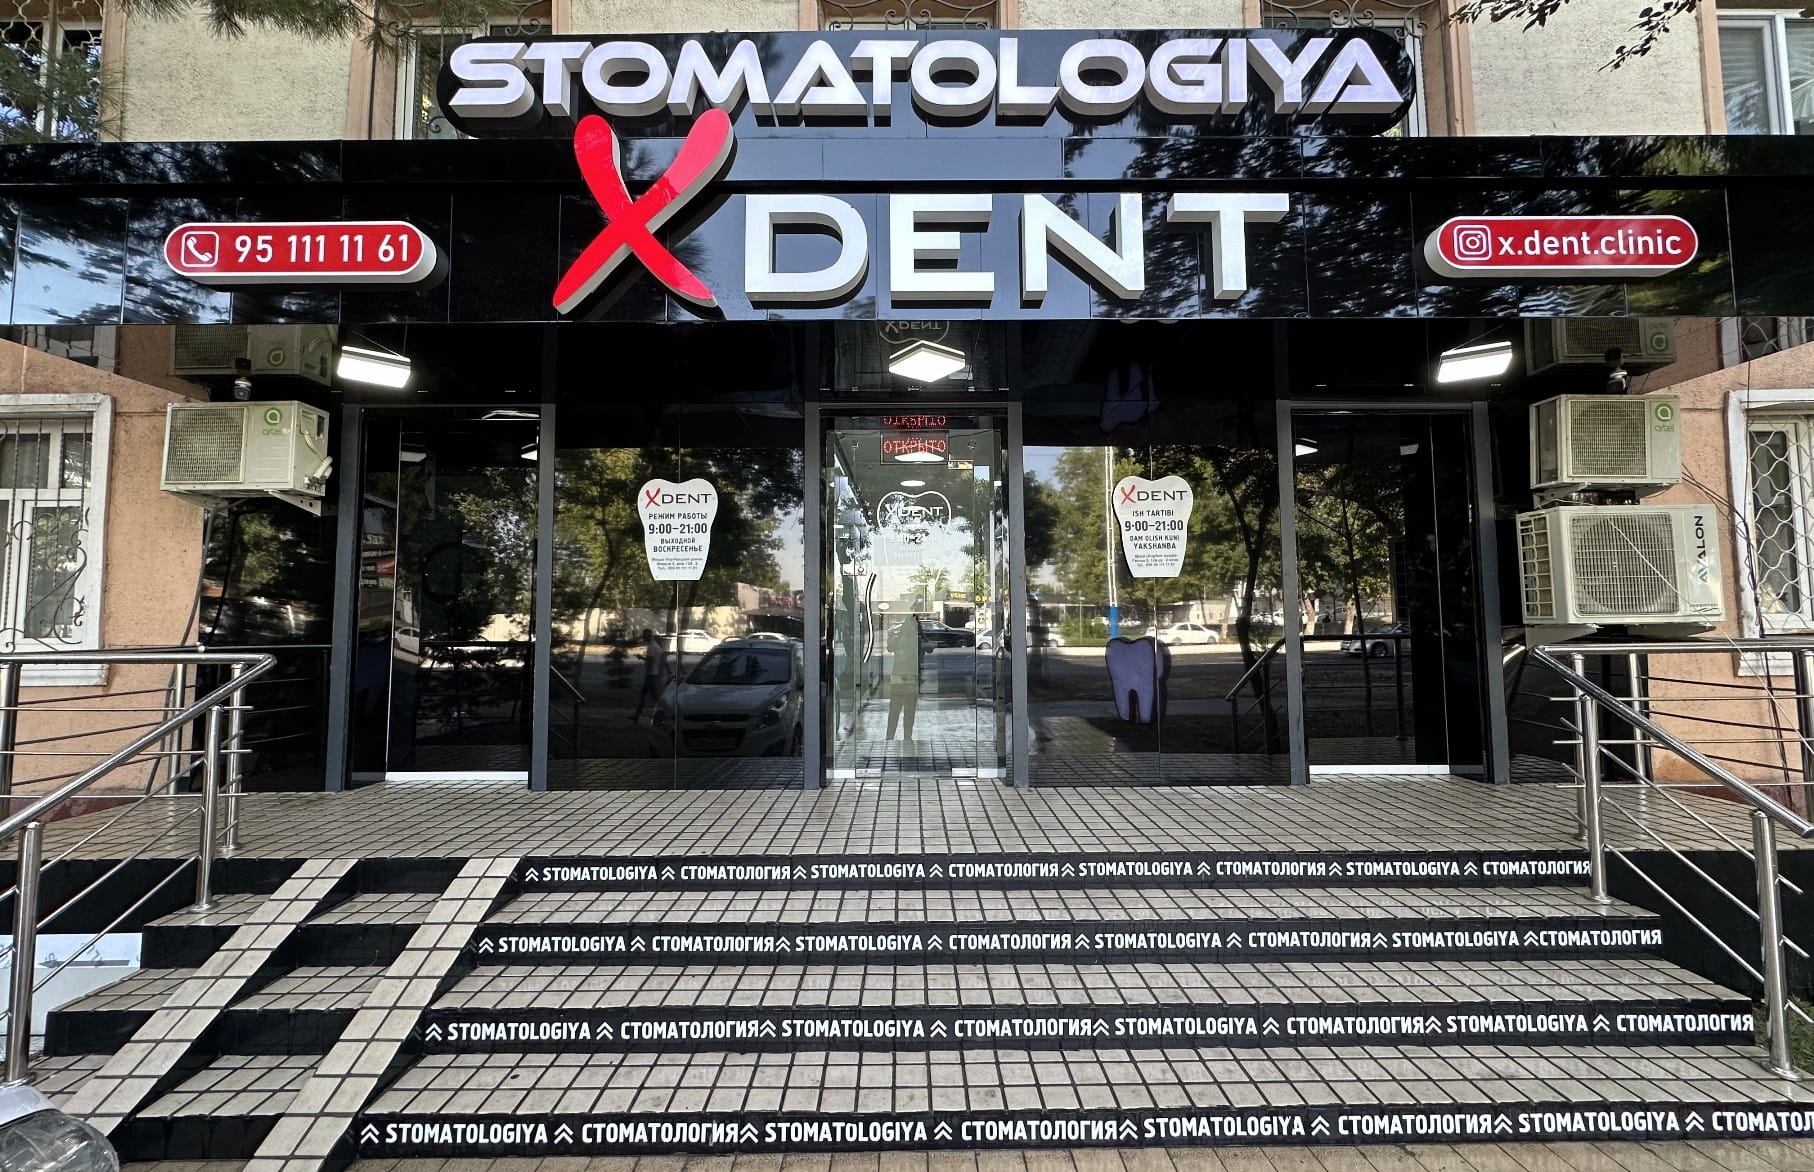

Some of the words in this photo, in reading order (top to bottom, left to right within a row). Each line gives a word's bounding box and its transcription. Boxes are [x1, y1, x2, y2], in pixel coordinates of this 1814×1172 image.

[450, 37, 1402, 113] STOMATOLOGIYA
[235, 235, 273, 263] 95
[288, 235, 325, 262] 111
[340, 235, 364, 262] 11
[378, 234, 409, 262] 61
[1498, 229, 1682, 257] x.dent.clinic
[883, 439, 946, 454] ОТКРЫТО
[677, 512, 708, 520] РАБОТЫ
[1147, 509, 1174, 517] TARTIBI
[653, 545, 703, 553] ВОСКРЕСЕНЬЕ
[660, 537, 696, 545] ВЫХОДНОЙ
[1693, 515, 1708, 583] AVALON
[543, 866, 657, 881] STOMATOLOGIYA
[681, 866, 790, 879] СТОМАТОЛОГИЯ
[811, 864, 925, 878] STOMATOLOGIYA
[949, 863, 1058, 877] СТОМАТОЛОГИЯ
[1079, 862, 1192, 876] STOMATOLOGIYA
[1217, 862, 1325, 875] СТОМАТОЛОГИЯ
[1347, 862, 1460, 875] STOMATOLOGIYA
[1483, 861, 1592, 875] СТОМАТОЛОГИЯ
[499, 936, 625, 952] STOMATOLOGIYA
[653, 936, 774, 951] СТОМАТОЛОГИЯ
[796, 935, 922, 951] STOMATOLOGIYA
[950, 934, 1071, 949] СТОМАТОЛОГИЯ
[1095, 933, 1222, 948] STOMATOLOGIYA
[1249, 932, 1370, 947] СТОМАТОЛОГИЯ
[1392, 931, 1519, 947] STOMATOLOGIYA
[1540, 930, 1661, 946] СТОМАТОЛОГИЯ
[448, 1022, 590, 1040] STOMATOLOGIYA
[621, 1020, 758, 1039] СТОМАТОЛОГИЯ
[782, 1020, 924, 1037] STOMATOLOGIYA
[955, 1019, 1091, 1037] СТОМАТОЛОГИЯ
[1115, 1018, 1257, 1035] STOMATOLOGIYA
[1287, 1017, 1424, 1034] СТОМАТОЛОГИЯ
[1447, 1015, 1588, 1032] STOMATOLOGIYA
[1617, 1014, 1754, 1031] СТОМАТОЛОГИЯ
[386, 1124, 547, 1143] STOMATOLOGIYA
[583, 1123, 738, 1143] СТОМАТОЛОГИЯ
[765, 1122, 927, 1142] STOMATOLOGIYA
[962, 1120, 1117, 1140] СТОМАТОЛОГИЯ
[1144, 1116, 1305, 1137] STOMATOLOGIYA
[1339, 1114, 1491, 1134] СТОМАТОЛОГИЯ
[1519, 1112, 1680, 1132] STOMATOLOGIYA
